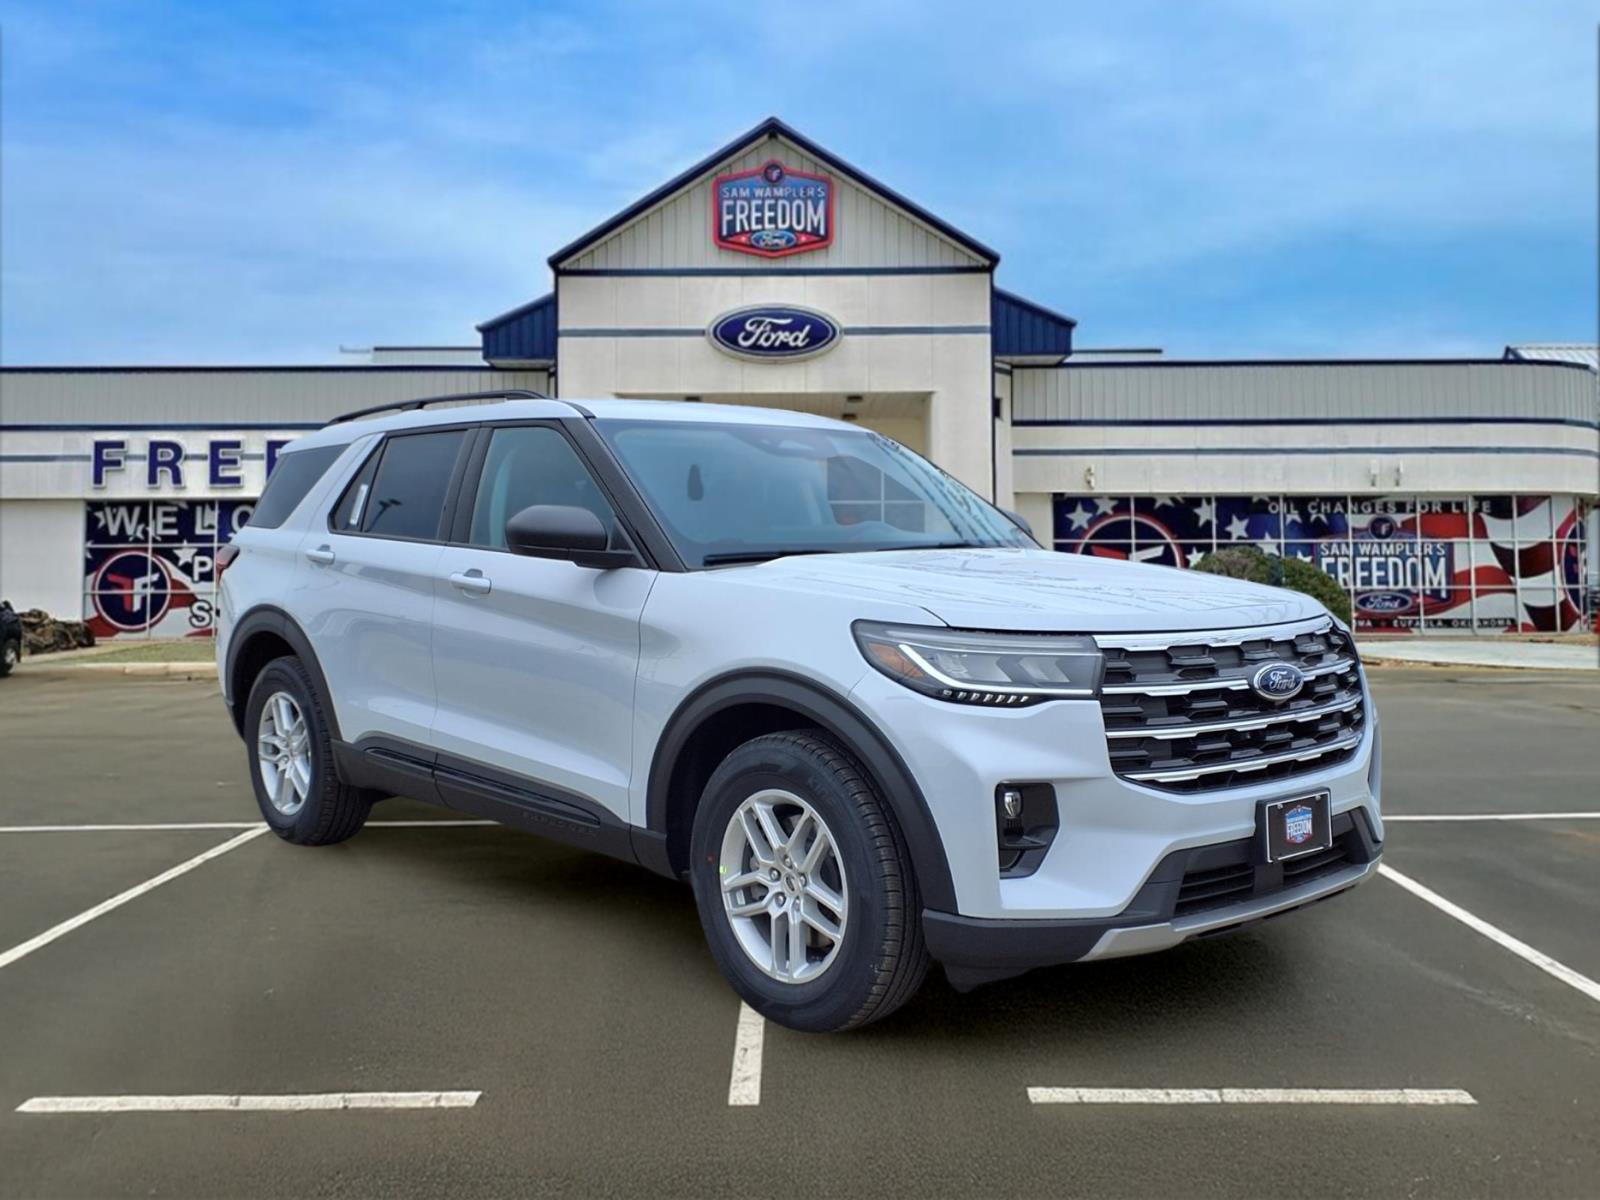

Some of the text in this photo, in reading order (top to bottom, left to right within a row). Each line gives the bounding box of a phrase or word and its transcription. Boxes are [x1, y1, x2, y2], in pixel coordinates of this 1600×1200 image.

[722, 187, 750, 198] SAM
[722, 200, 825, 237] FREEDOM
[759, 232, 787, 248] Ford
[737, 316, 812, 348] Ford
[1268, 501, 1492, 514] OIL CHANGES FOR LIFE
[1365, 594, 1400, 609] Ford
[1268, 670, 1297, 691] Ford
